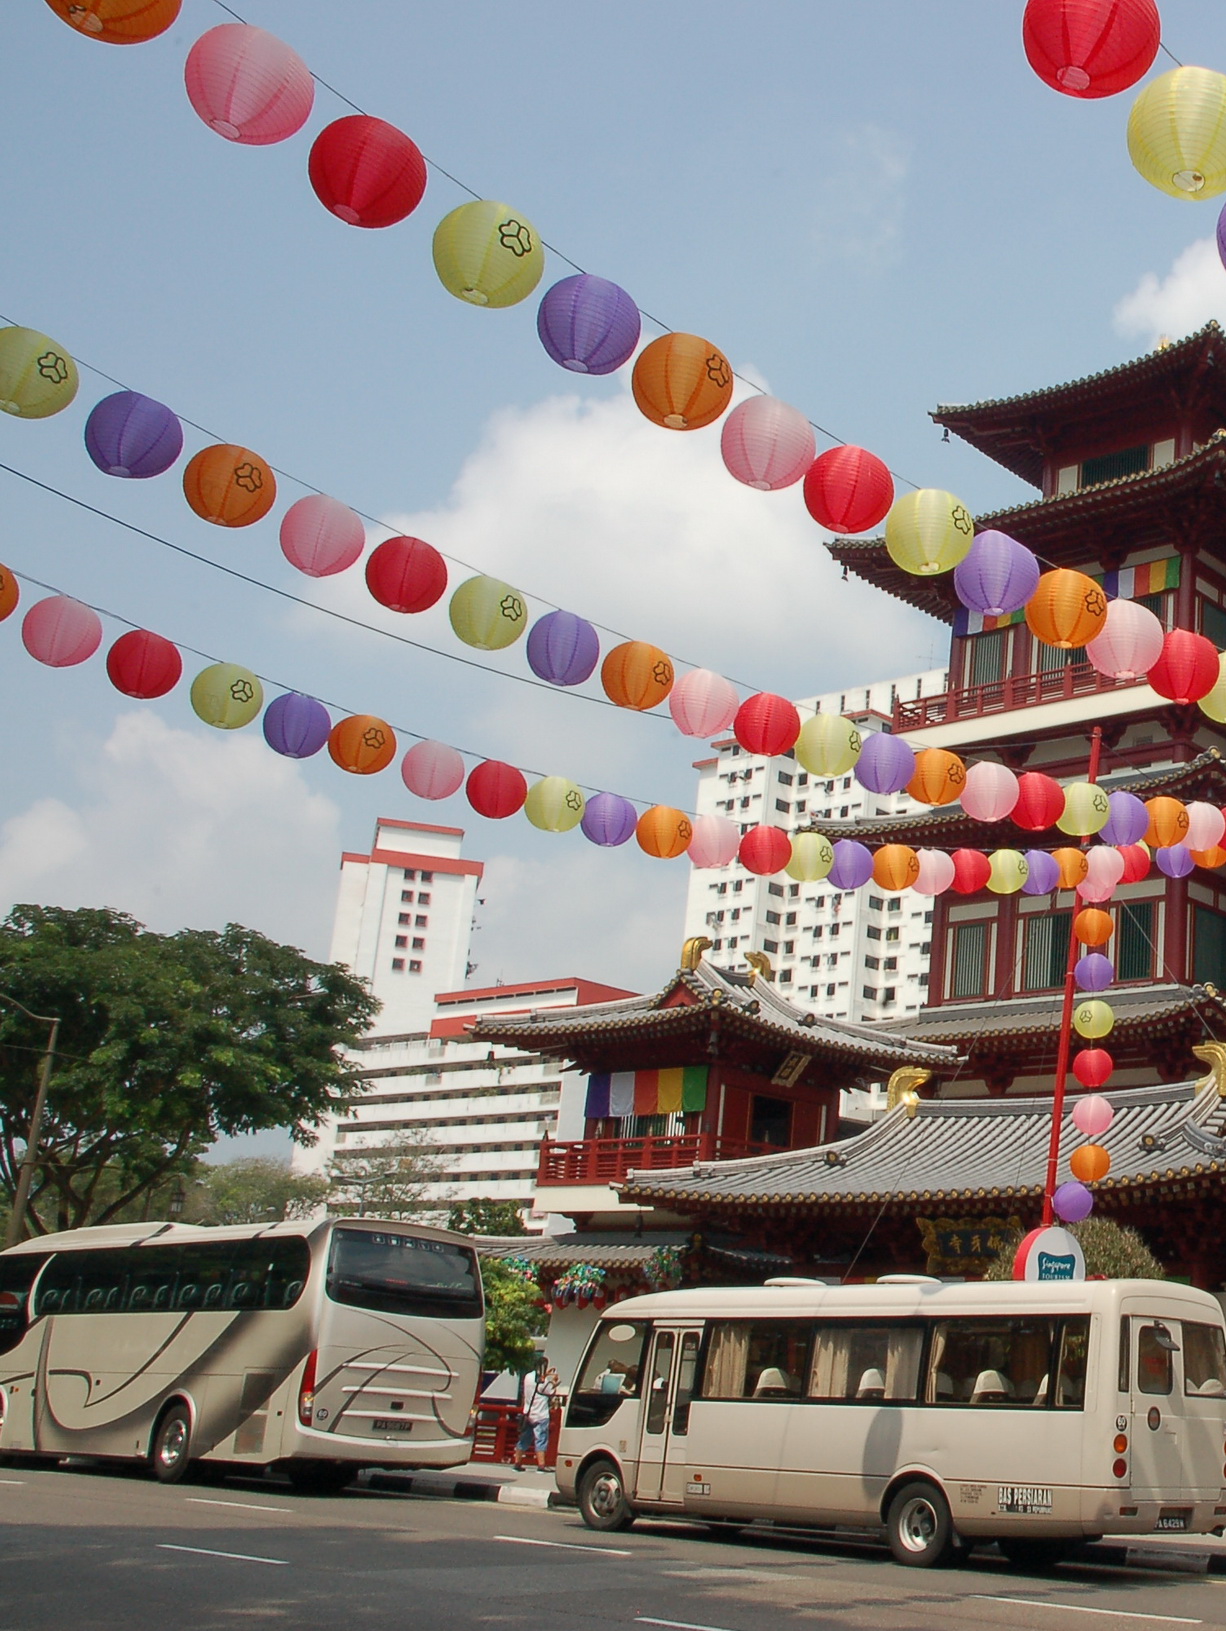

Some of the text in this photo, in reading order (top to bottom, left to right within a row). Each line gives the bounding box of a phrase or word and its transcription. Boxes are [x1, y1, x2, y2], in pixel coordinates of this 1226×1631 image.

[1042, 1257, 1071, 1274] Singapore
[998, 1487, 1012, 1504] BAS
[1013, 1487, 1052, 1506] PERSIARAN
